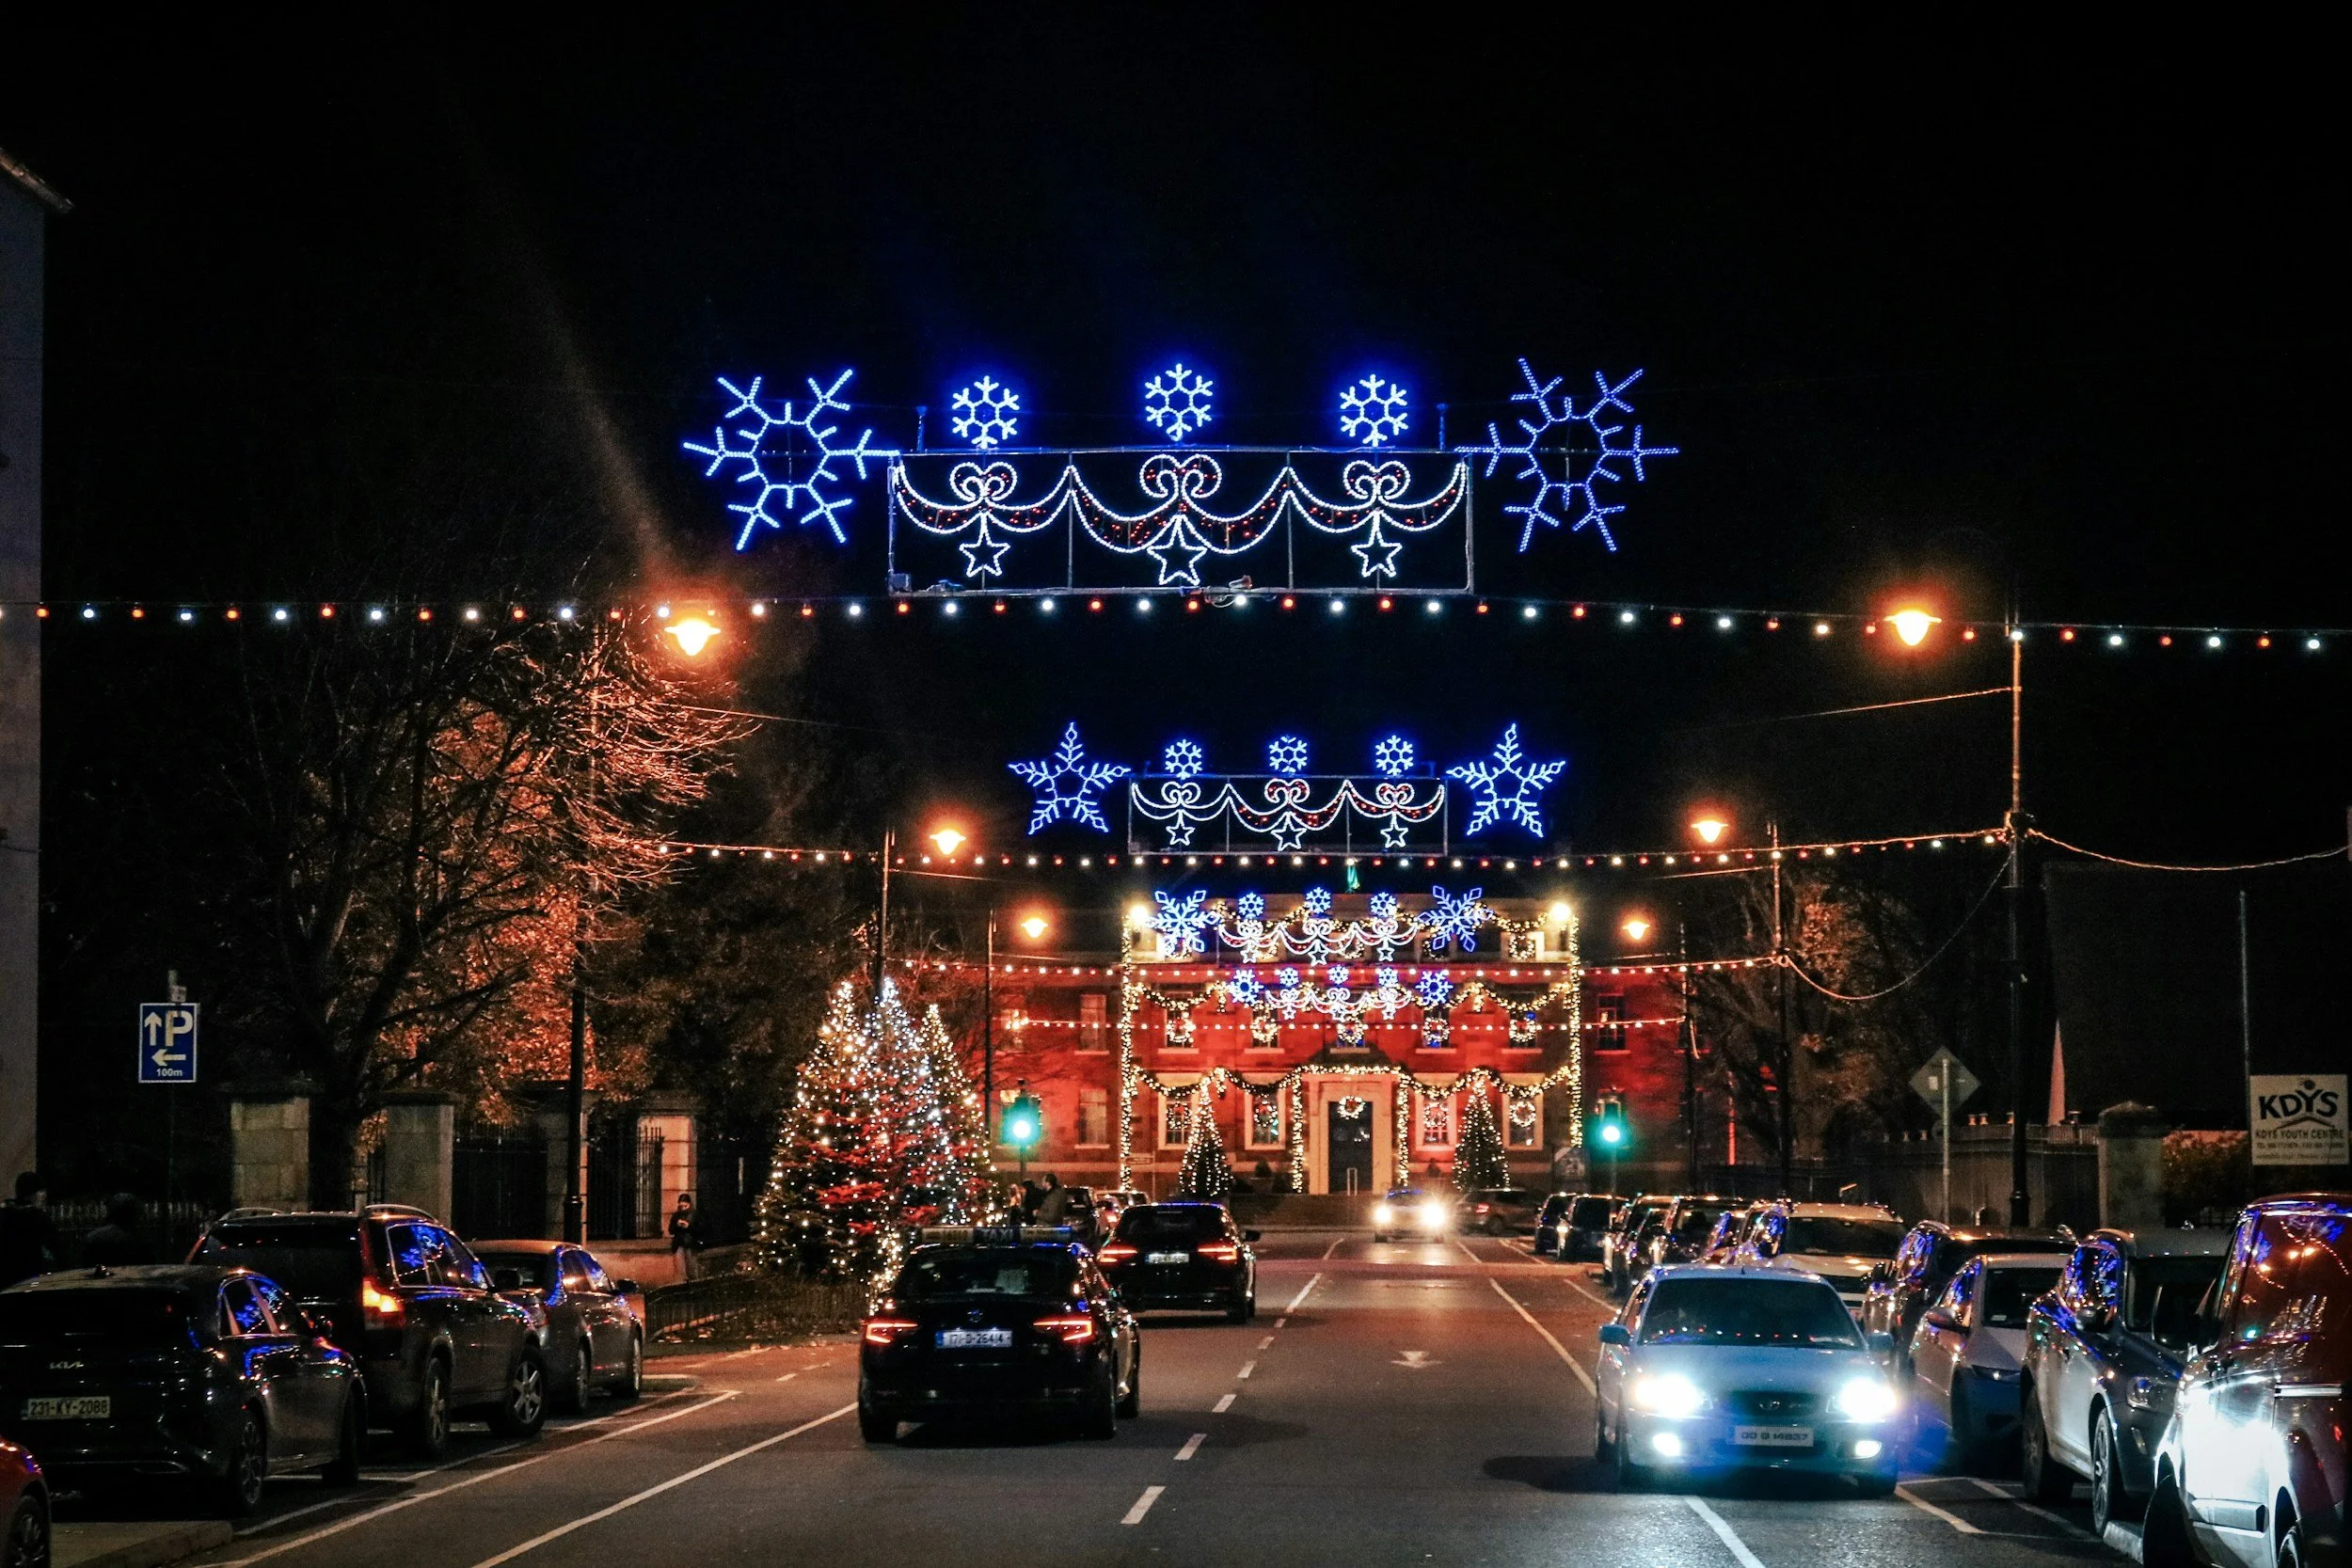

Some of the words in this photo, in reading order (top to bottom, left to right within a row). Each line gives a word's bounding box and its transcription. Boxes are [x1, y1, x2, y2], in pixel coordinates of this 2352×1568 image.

[165, 1010, 194, 1047] P
[156, 1068, 183, 1077] 100m
[2259, 1088, 2339, 1120] KDYS
[2256, 1129, 2278, 1140] KDYS
[2280, 1129, 2309, 1140] YOUTH
[2311, 1129, 2344, 1140] CENTRE
[983, 1227, 1014, 1243] TAXI
